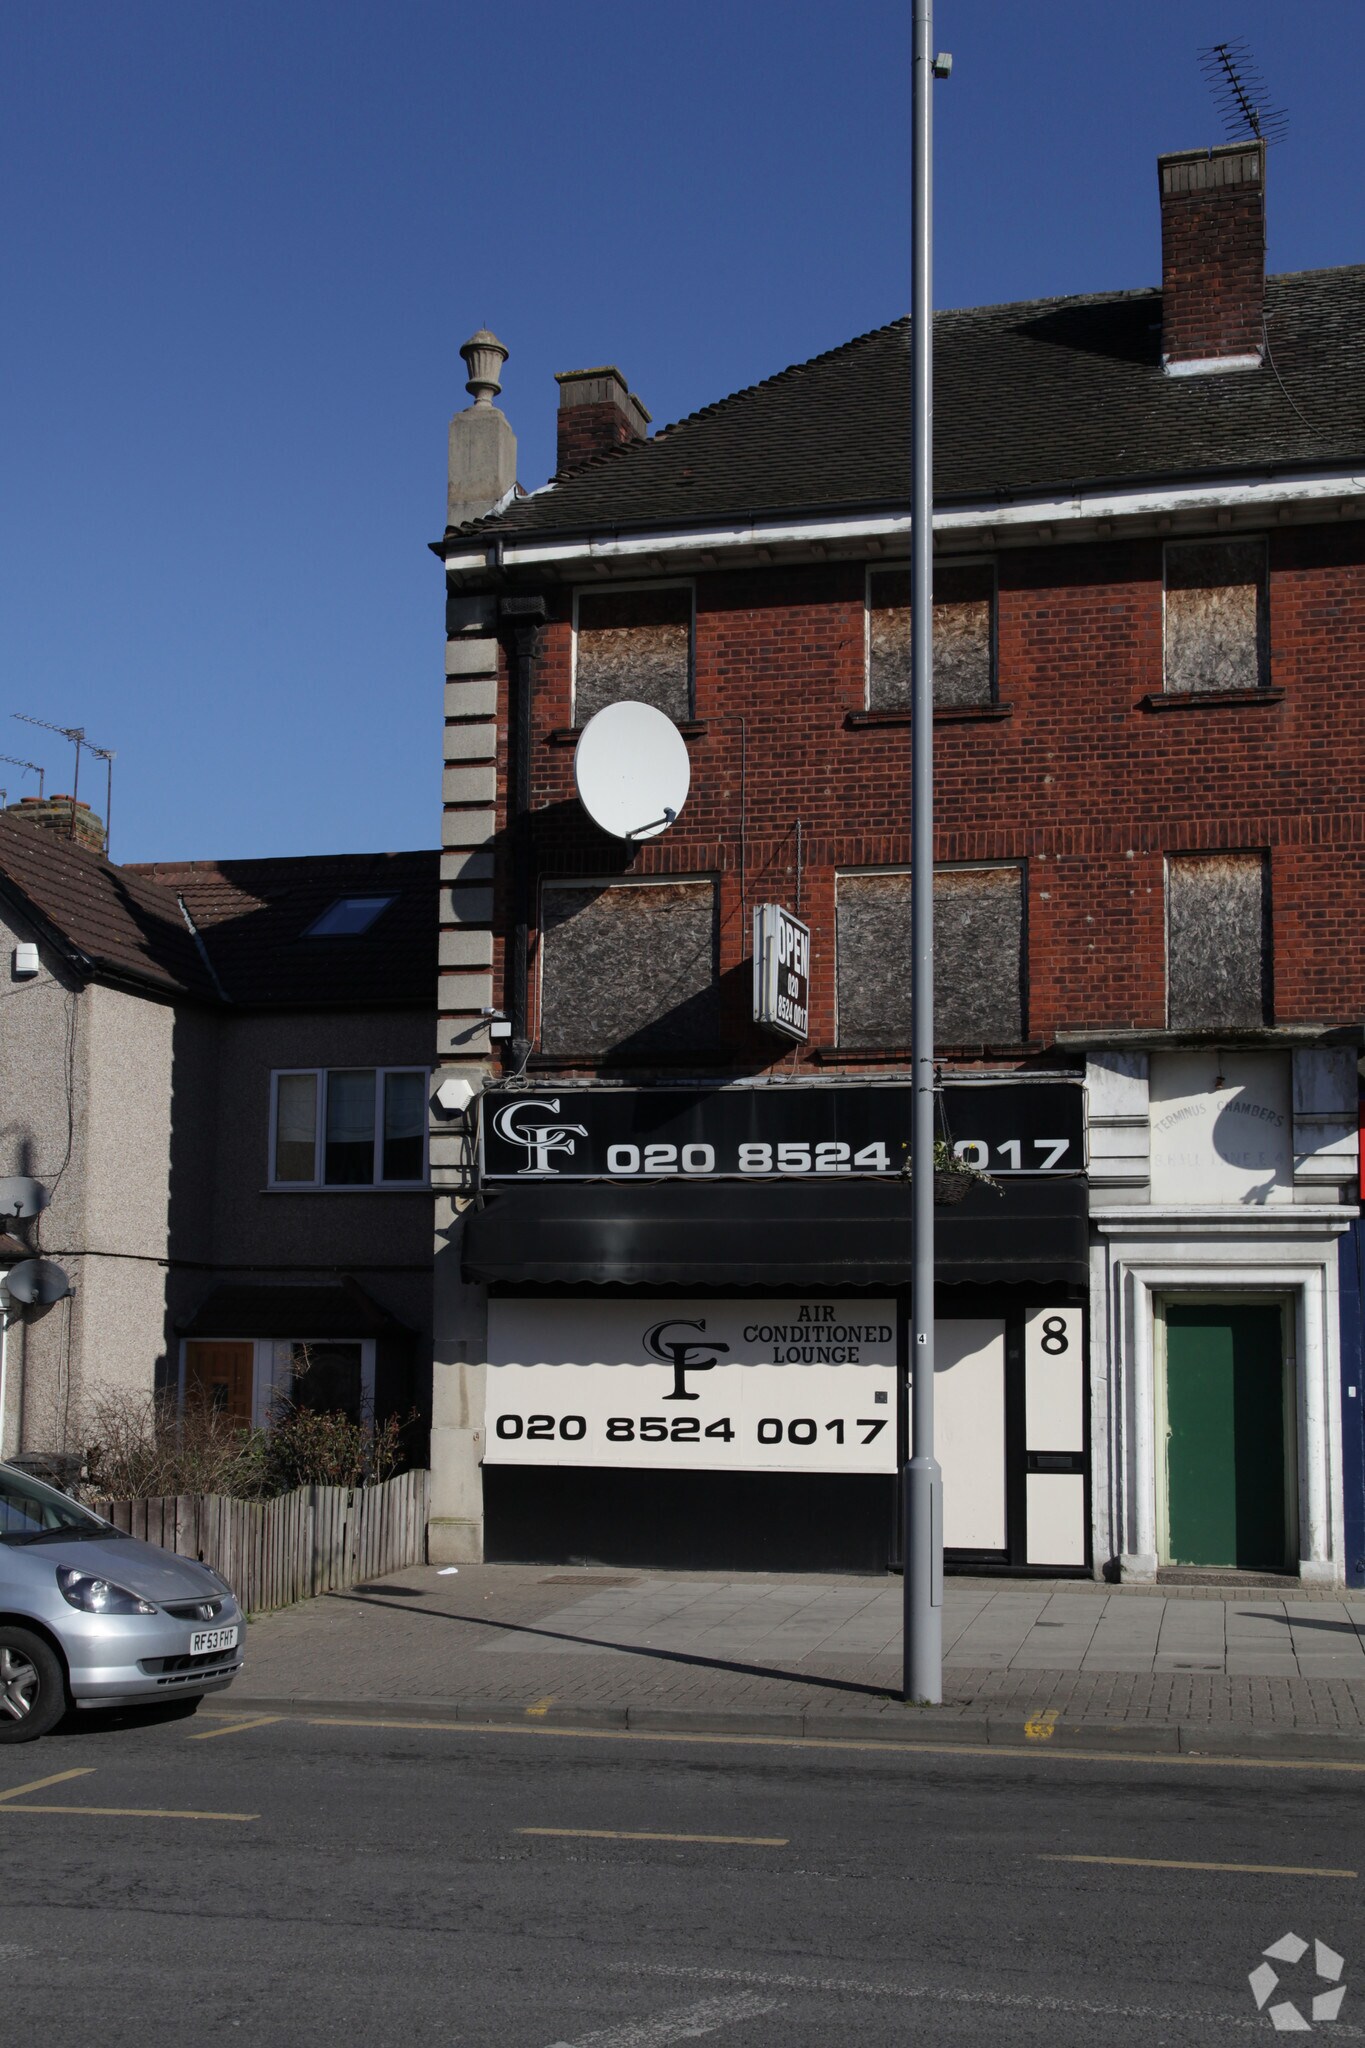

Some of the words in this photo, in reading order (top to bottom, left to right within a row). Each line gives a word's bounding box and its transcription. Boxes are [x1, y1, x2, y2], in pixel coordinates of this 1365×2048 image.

[778, 916, 808, 979] OPEN
[787, 972, 799, 999] 020
[778, 994, 793, 1024] 8524
[794, 1003, 807, 1030] 0017
[1153, 1102, 1207, 1134] TERMINUS
[1216, 1100, 1285, 1128] CHAMBERS
[607, 1142, 715, 1174] 020
[739, 1140, 891, 1173] 8524
[930, 1138, 1070, 1171] 017
[797, 1304, 837, 1323] AIR
[743, 1325, 893, 1343] CONDITIONED
[918, 1334, 925, 1344] 4
[1041, 1316, 1070, 1356] 8
[773, 1346, 860, 1365] LOUNGE
[496, 1414, 588, 1442] 020
[605, 1416, 736, 1443] 8524
[756, 1417, 889, 1446] 0017
[193, 1632, 218, 1651] RF53
